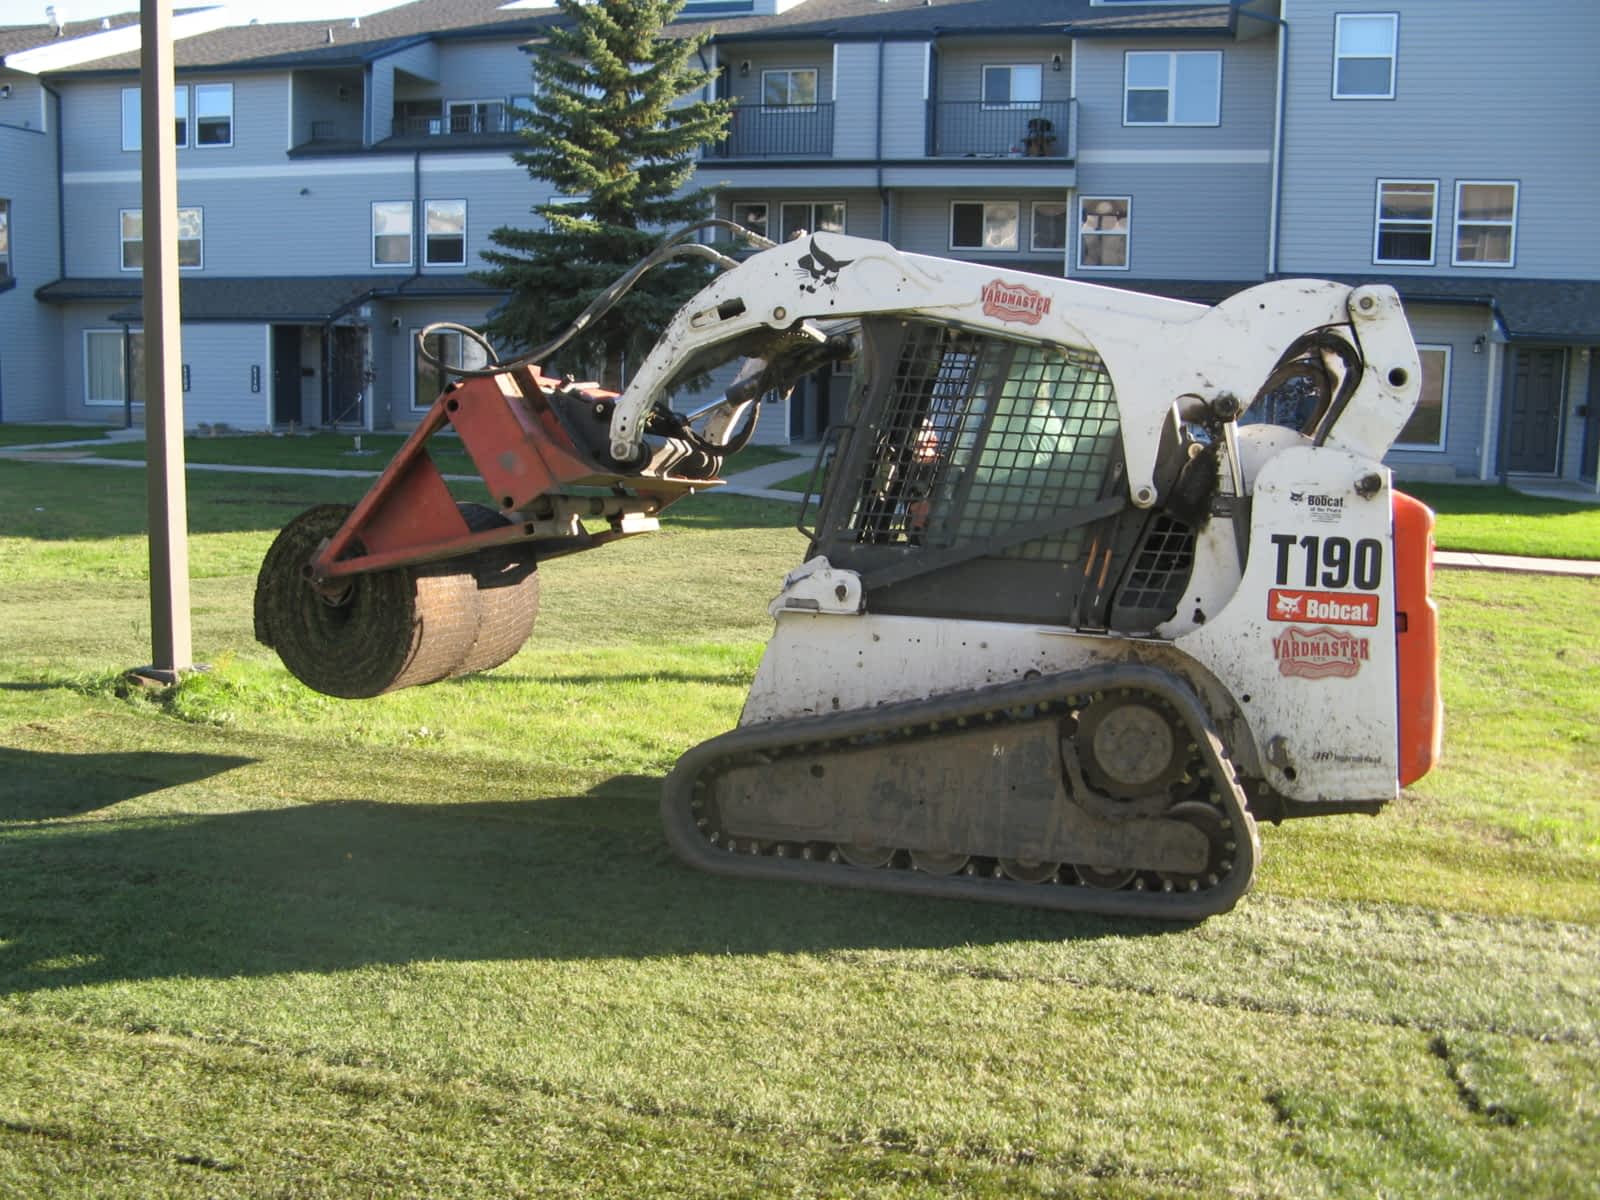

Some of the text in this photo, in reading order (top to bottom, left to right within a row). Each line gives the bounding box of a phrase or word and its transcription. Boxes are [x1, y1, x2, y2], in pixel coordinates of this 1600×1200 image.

[981, 285, 1052, 315] YARDMASTER
[1308, 494, 1344, 507] Bobcat
[1271, 533, 1383, 591] T190
[1305, 599, 1369, 622] Bobcat
[1272, 637, 1369, 660] YARDMASTER
